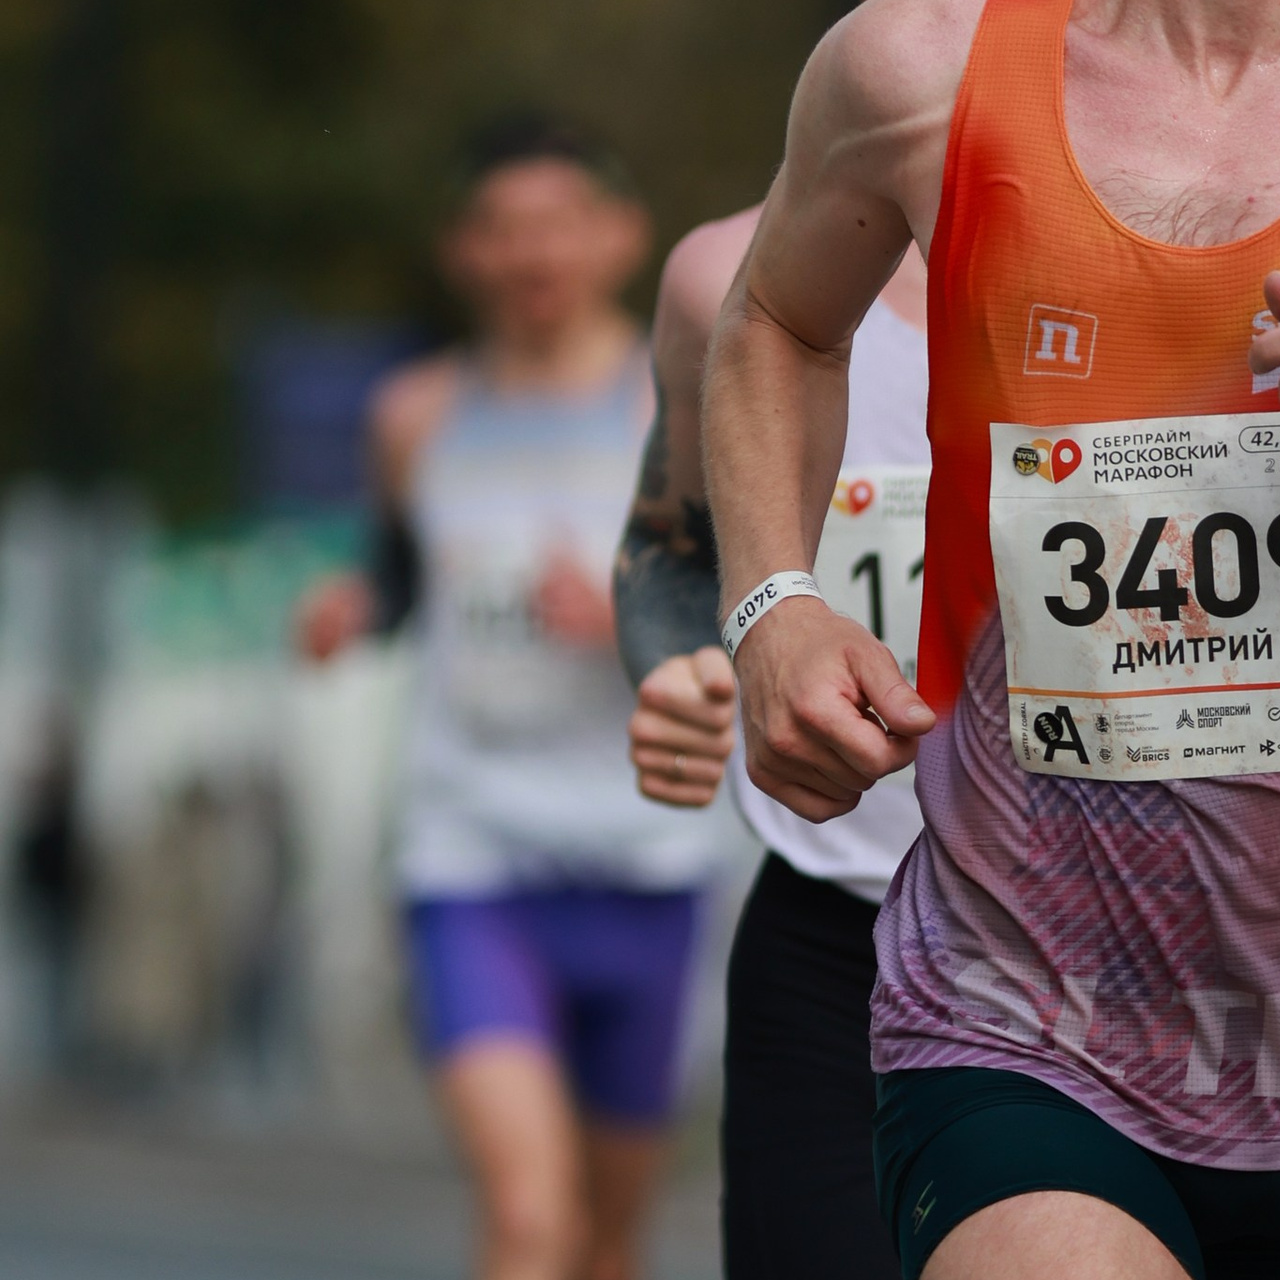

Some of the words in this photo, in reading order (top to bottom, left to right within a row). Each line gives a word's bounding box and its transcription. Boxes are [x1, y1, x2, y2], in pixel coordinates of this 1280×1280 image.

[1092, 429, 1191, 449] СБЕРПРАЙМ
[1093, 441, 1228, 466] МОСКОВСКИЙ
[1094, 463, 1193, 484] МАРАФОН
[736, 583, 777, 628] 3409
[1111, 627, 1274, 674] ДМИТРИЙ
[1196, 703, 1251, 718] МОСКОВСКИЙ
[1038, 716, 1058, 741] RUN
[1197, 717, 1223, 729] СПОРТ
[1142, 753, 1170, 762] BRICS
